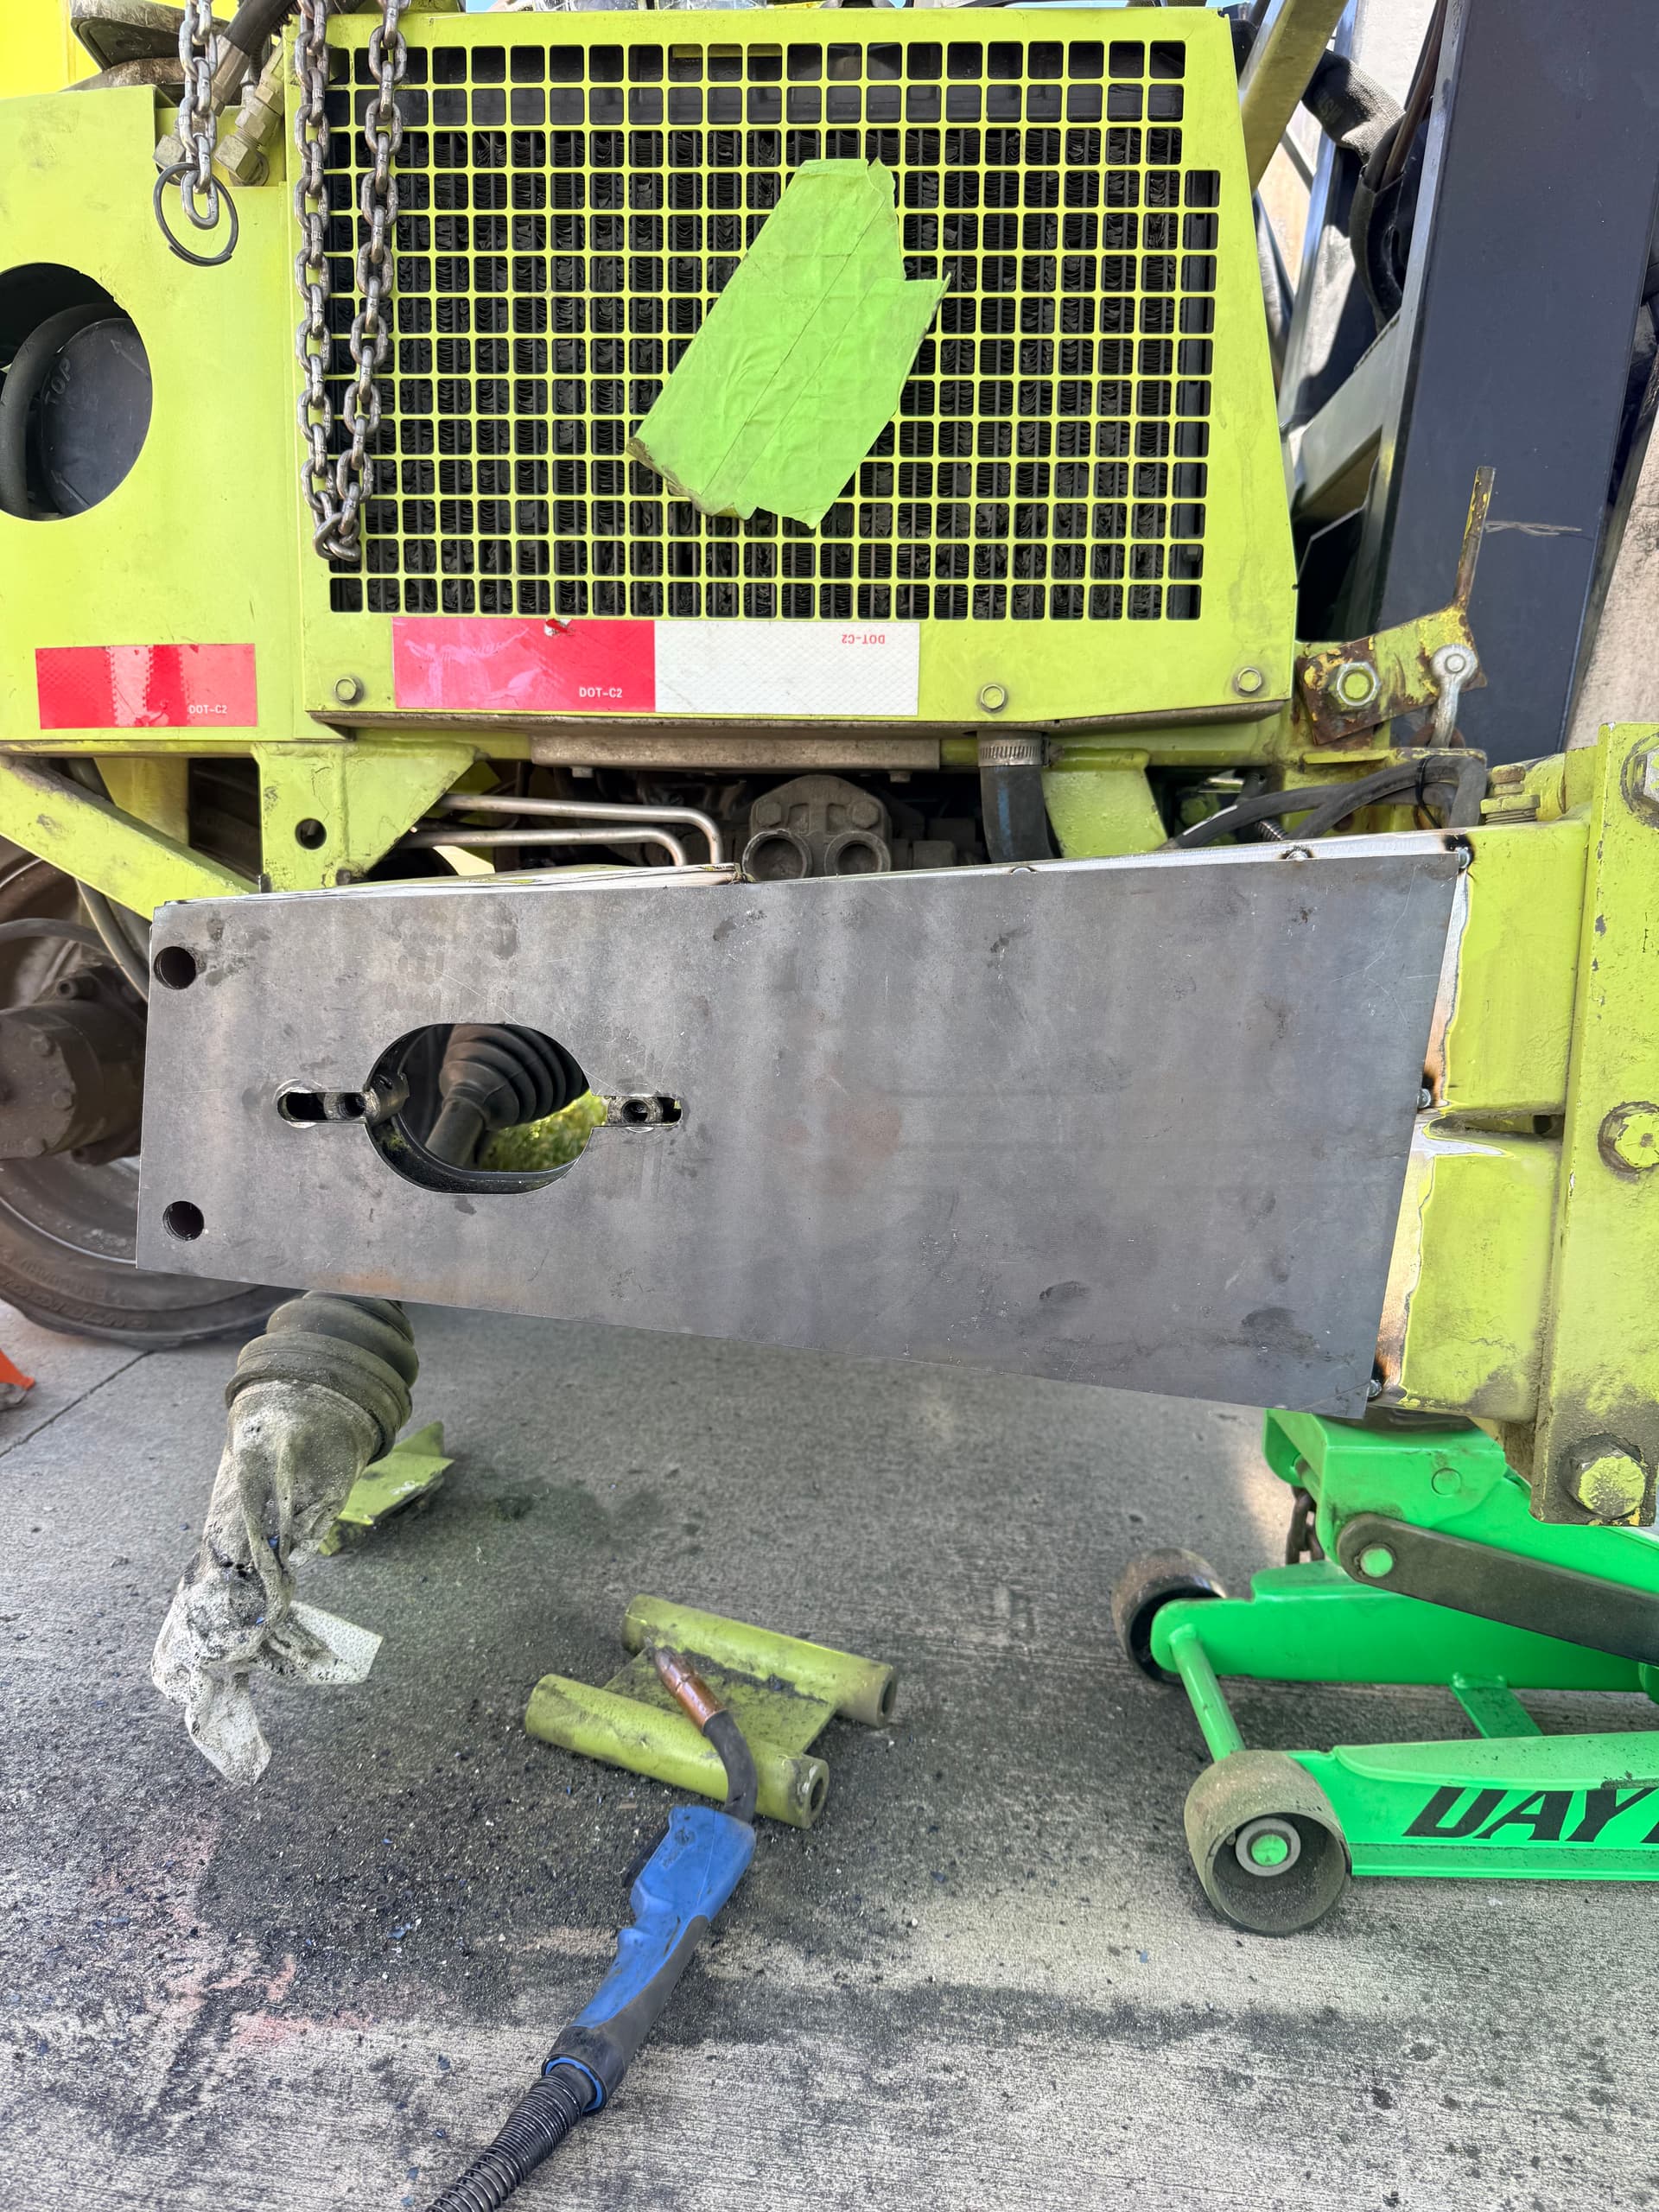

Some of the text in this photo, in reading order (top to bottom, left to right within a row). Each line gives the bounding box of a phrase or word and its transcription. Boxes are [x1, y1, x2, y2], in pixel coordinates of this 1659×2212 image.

[44, 357, 71, 405] TOP
[841, 633, 886, 645] DOT-C2
[578, 687, 623, 698] DOT-C2
[188, 704, 228, 714] DOT-C2
[1401, 1785, 1659, 1843] DAY
